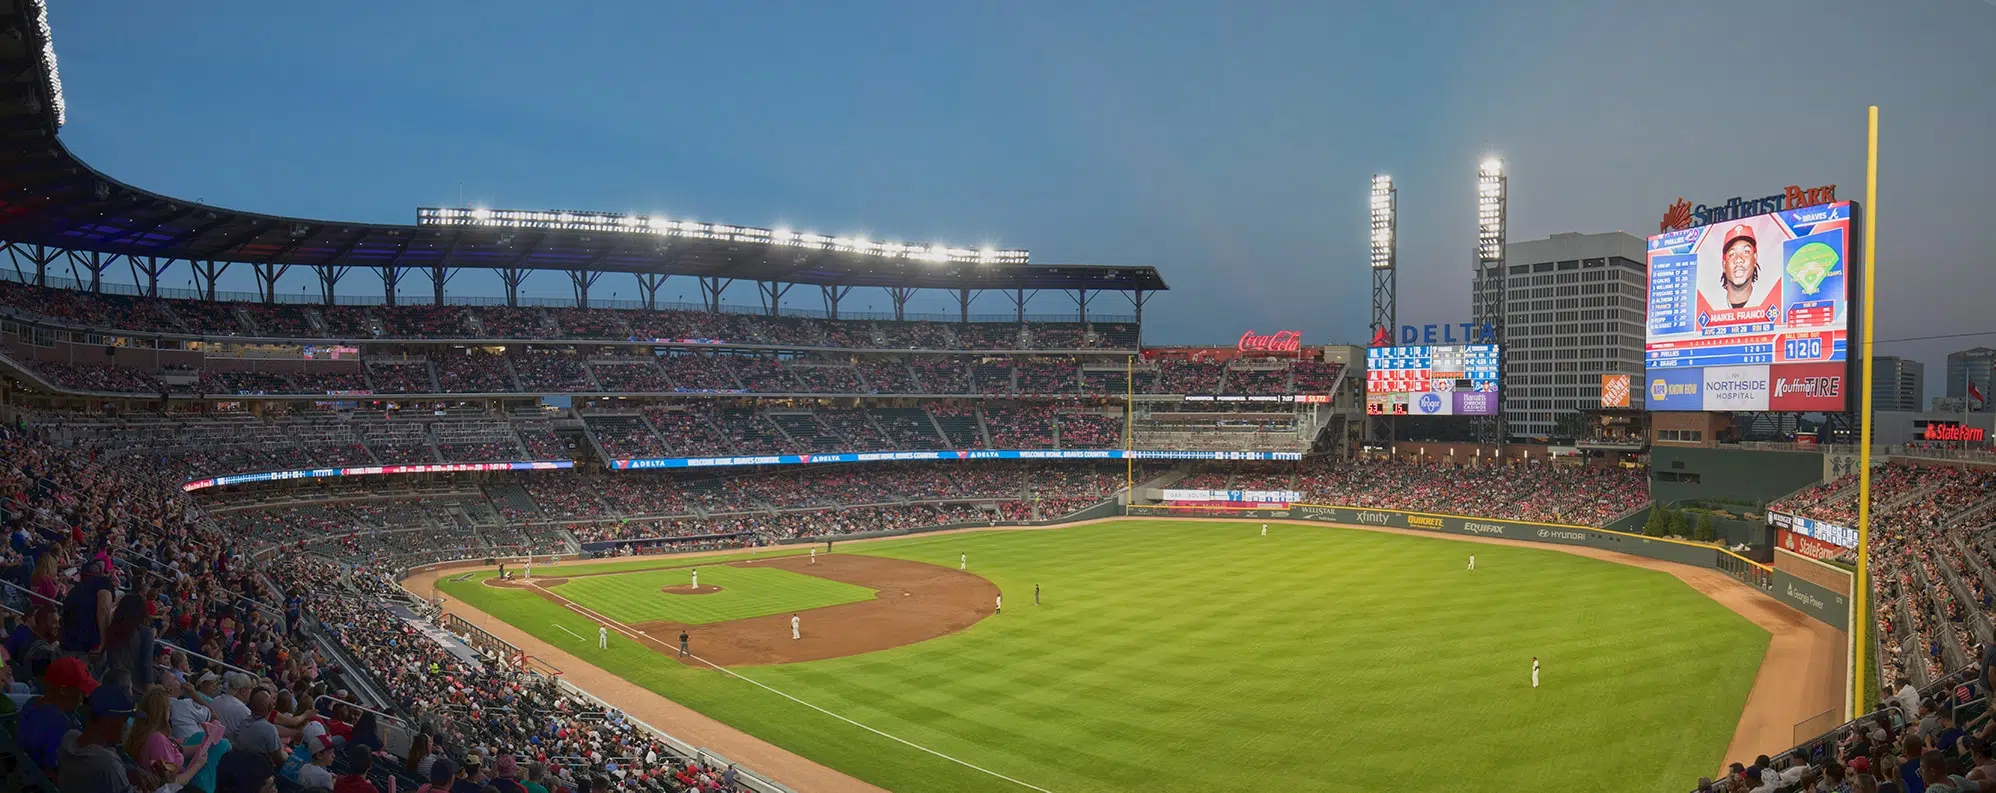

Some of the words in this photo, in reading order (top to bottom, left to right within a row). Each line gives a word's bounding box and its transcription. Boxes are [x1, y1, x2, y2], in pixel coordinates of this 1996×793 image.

[1784, 183, 1837, 210] PARK
[1802, 212, 1827, 222] BRAVES
[1664, 236, 1685, 246] PHILLIES
[1710, 312, 1736, 322] MAIKEL
[1736, 310, 1766, 320] FRANCO
[1401, 322, 1496, 344] DELTA
[1788, 343, 1794, 356] 1
[1800, 342, 1807, 356] 2
[1812, 342, 1820, 355] 0
[1602, 375, 1630, 406] HOME
[1706, 380, 1766, 391] NORTHSIDE
[1774, 378, 1816, 397] Kauffman
[1804, 376, 1840, 398] TIRE
[1716, 392, 1754, 400] HOSPITAL
[1302, 506, 1336, 515] WELLSTAR
[1356, 510, 1390, 525] xfinity
[1408, 515, 1444, 527] QUIKRETE
[1464, 522, 1504, 534] EQUIFAX
[1551, 530, 1586, 540] HYUNDAI
[1794, 588, 1810, 604] Georgia
[1809, 595, 1824, 609] Power
